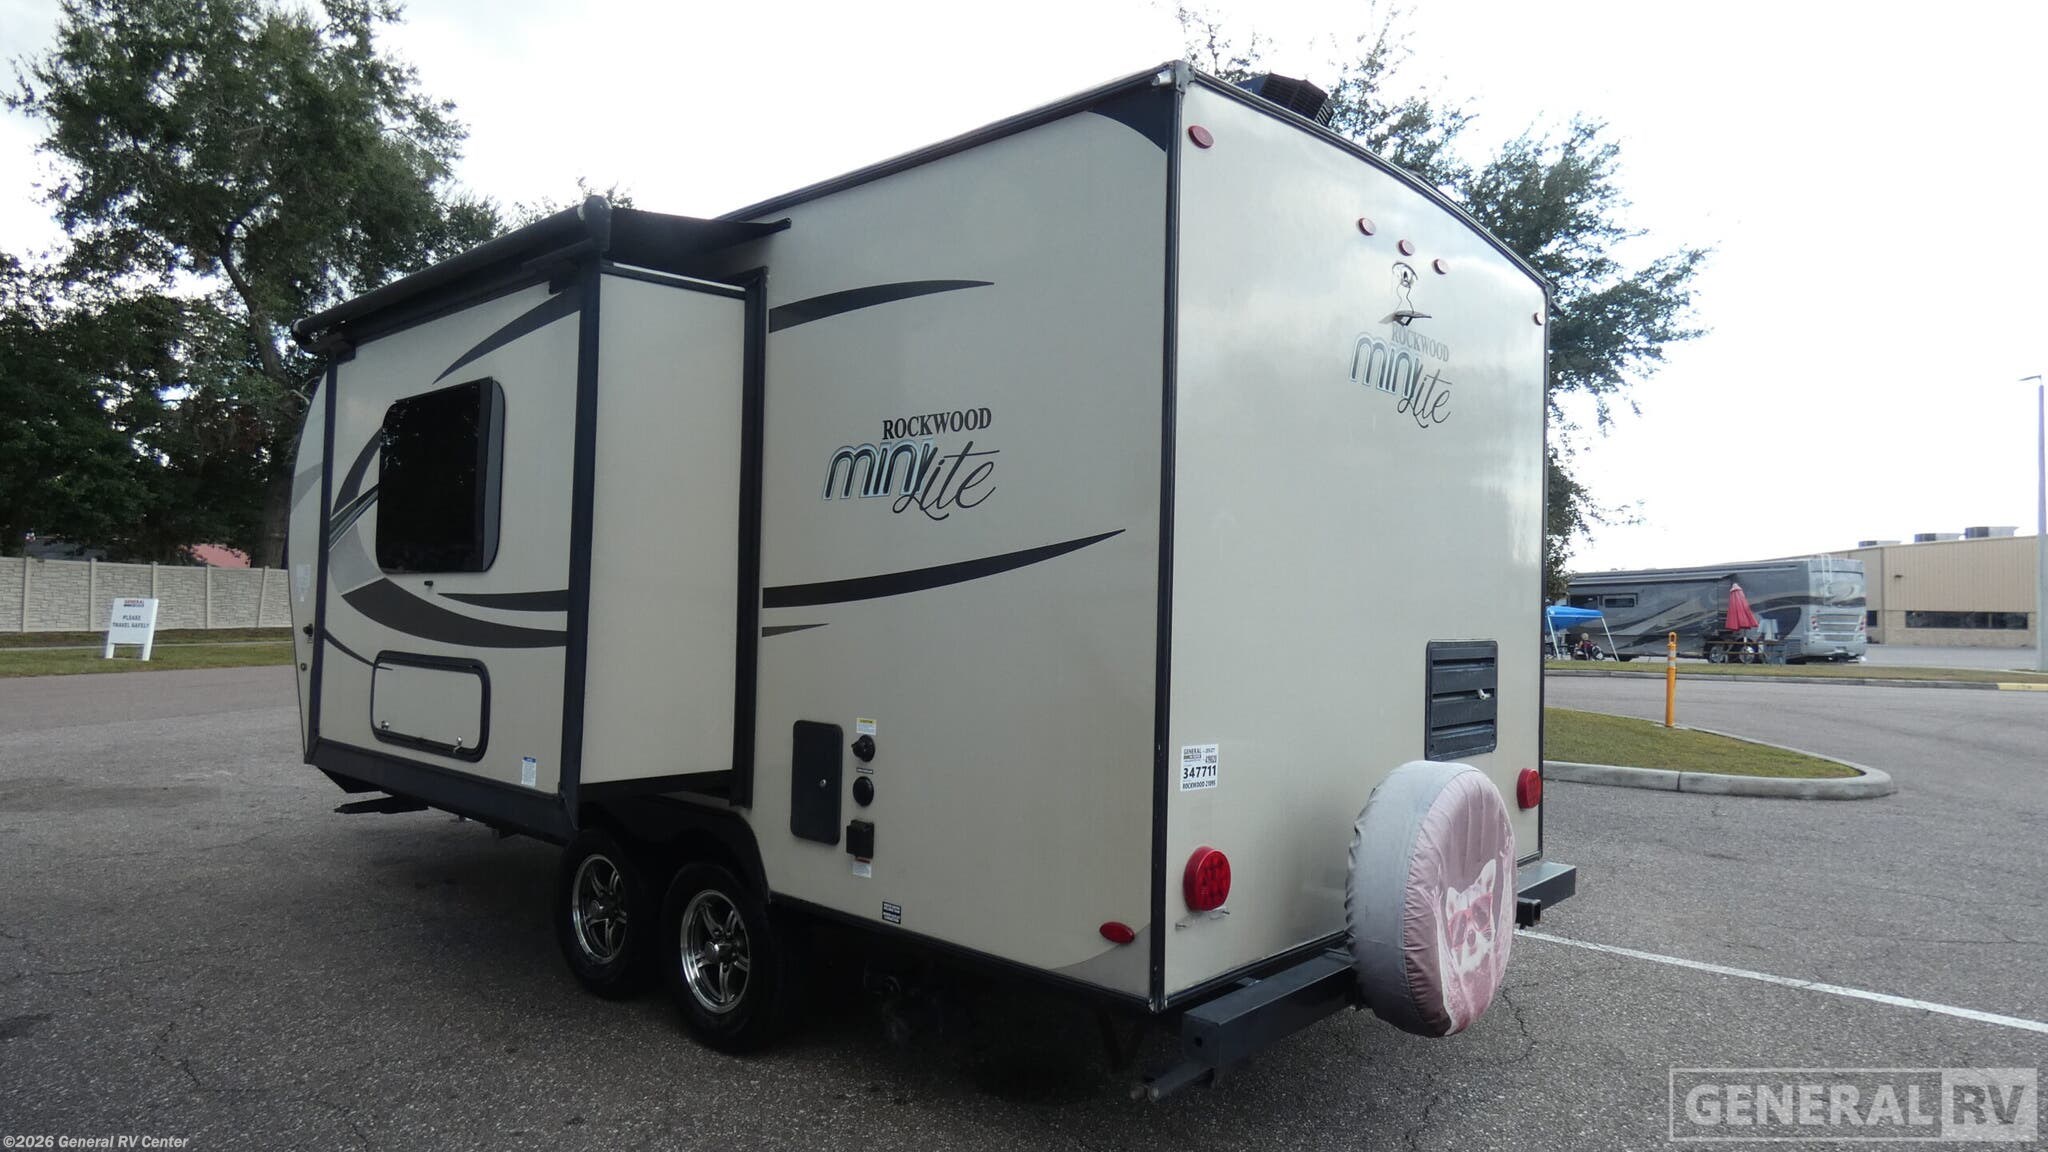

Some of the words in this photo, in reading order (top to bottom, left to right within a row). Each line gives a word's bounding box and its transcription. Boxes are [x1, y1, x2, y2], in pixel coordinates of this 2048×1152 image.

[1392, 324, 1450, 362] ROCKWOOD
[882, 407, 992, 440] ROCKWOOD
[1183, 765, 1216, 779] 347711
